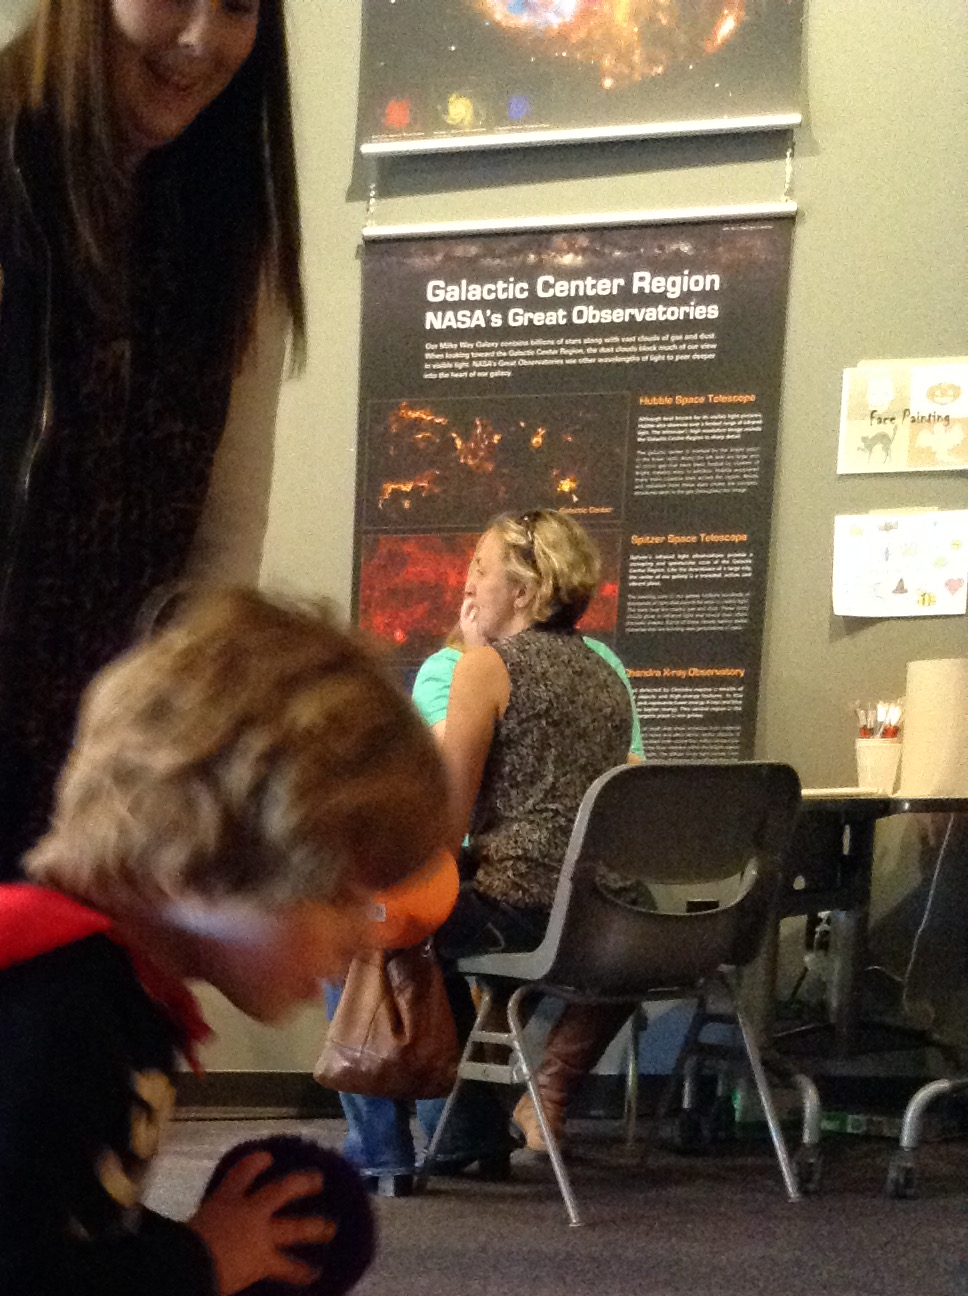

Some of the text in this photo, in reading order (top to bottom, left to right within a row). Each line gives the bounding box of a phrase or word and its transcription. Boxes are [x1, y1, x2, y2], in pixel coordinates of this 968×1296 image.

[426, 269, 721, 302] Galactic Center Region
[425, 300, 719, 330] NASA's Great Observatories
[639, 393, 756, 406] Hubble Space Telescope
[870, 408, 951, 428] Face Painting
[667, 533, 697, 545] Space
[699, 533, 749, 544] Telescope
[663, 667, 686, 678] X-ray
[688, 667, 744, 678] Observatory
